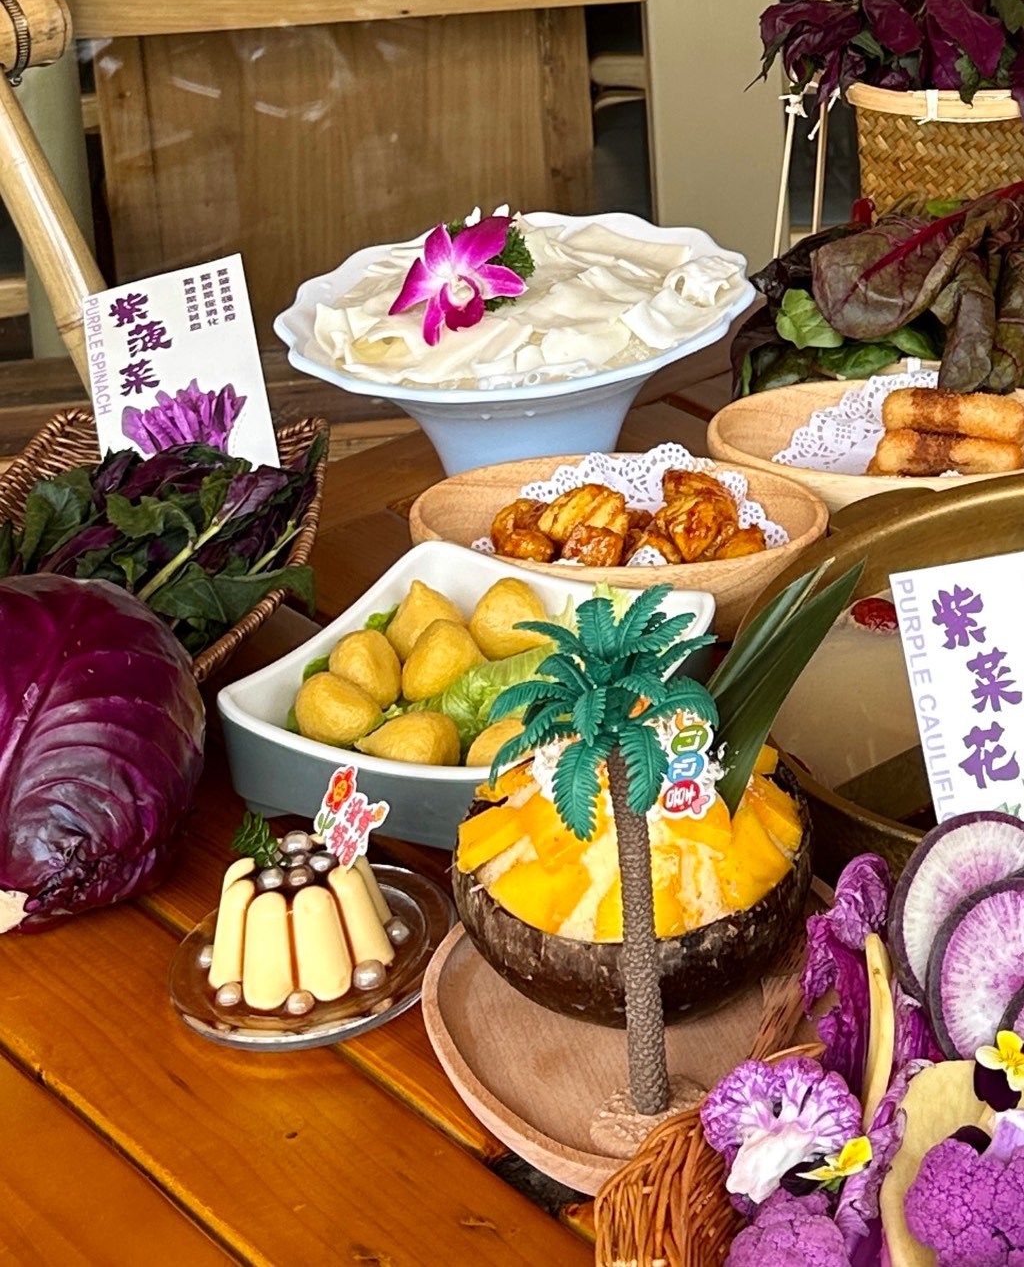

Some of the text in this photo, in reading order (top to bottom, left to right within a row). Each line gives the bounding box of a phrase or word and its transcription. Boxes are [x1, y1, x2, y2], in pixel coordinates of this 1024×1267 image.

[84, 297, 113, 416] PURPLE SPINACH
[108, 292, 173, 397] 紫菠菜
[895, 578, 934, 686] PURPLE
[932, 584, 1023, 789] 紫菜花
[664, 709, 705, 809] 门见喜
